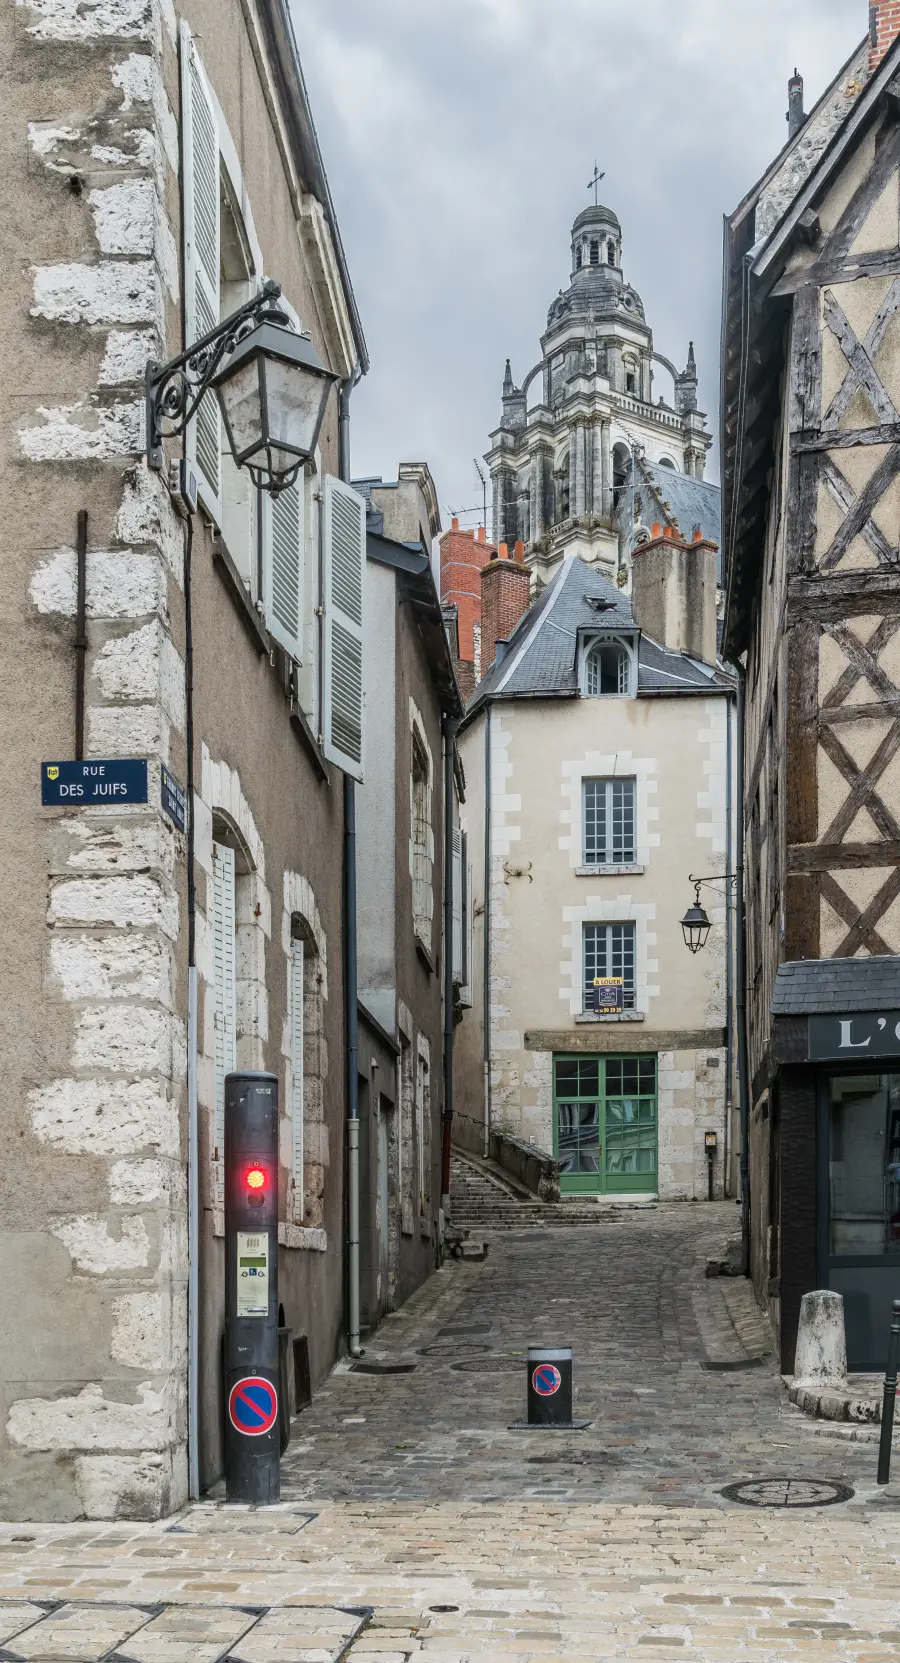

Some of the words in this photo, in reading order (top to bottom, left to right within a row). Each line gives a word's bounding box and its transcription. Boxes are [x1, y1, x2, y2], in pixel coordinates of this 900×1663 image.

[82, 766, 106, 777] RUE
[59, 784, 84, 797] DES
[92, 783, 128, 796] JUIFS
[837, 1017, 900, 1048] L'
